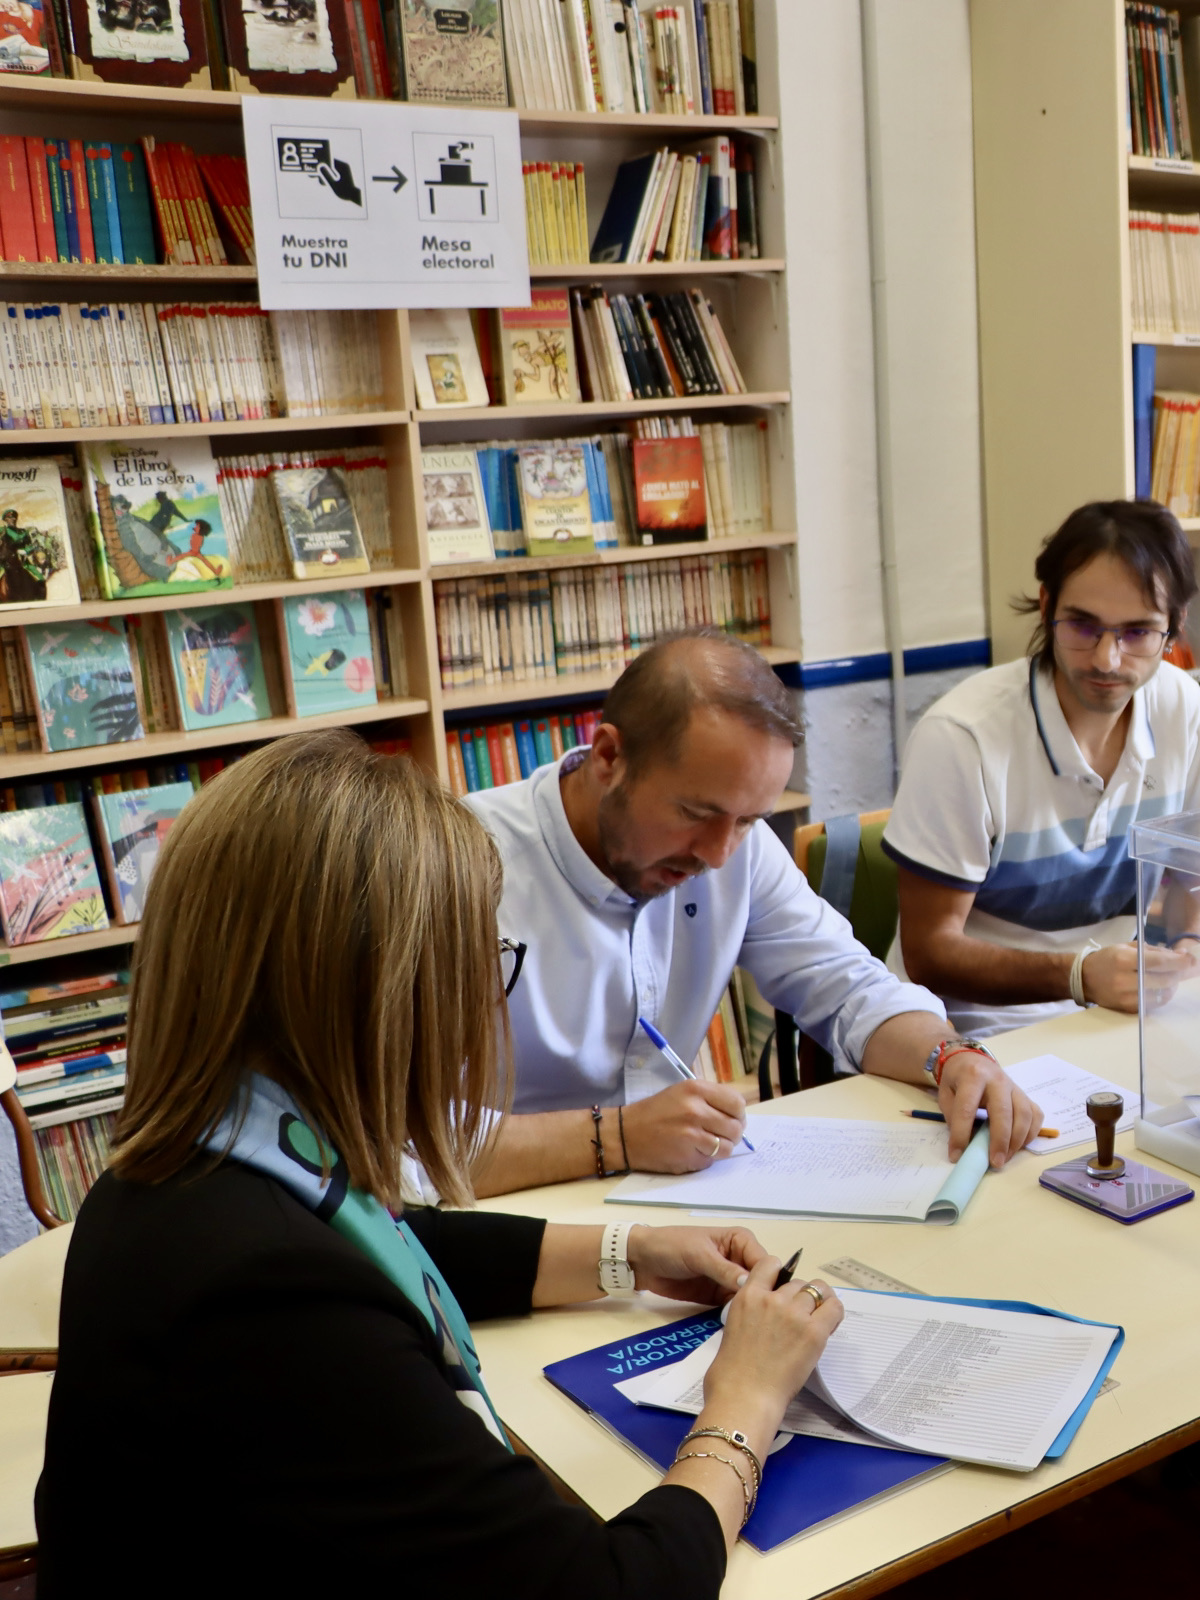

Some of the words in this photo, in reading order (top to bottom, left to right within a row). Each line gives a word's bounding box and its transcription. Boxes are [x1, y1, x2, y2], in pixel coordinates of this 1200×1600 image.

[281, 235, 348, 249] Muestra
[421, 235, 472, 252] Mesa
[283, 253, 303, 268] tu
[310, 252, 348, 269] DNI
[422, 253, 495, 269] electoral
[113, 459, 130, 473] El
[133, 458, 168, 472] libro
[116, 473, 134, 486] de
[139, 472, 152, 486] la
[156, 470, 195, 484] selva
